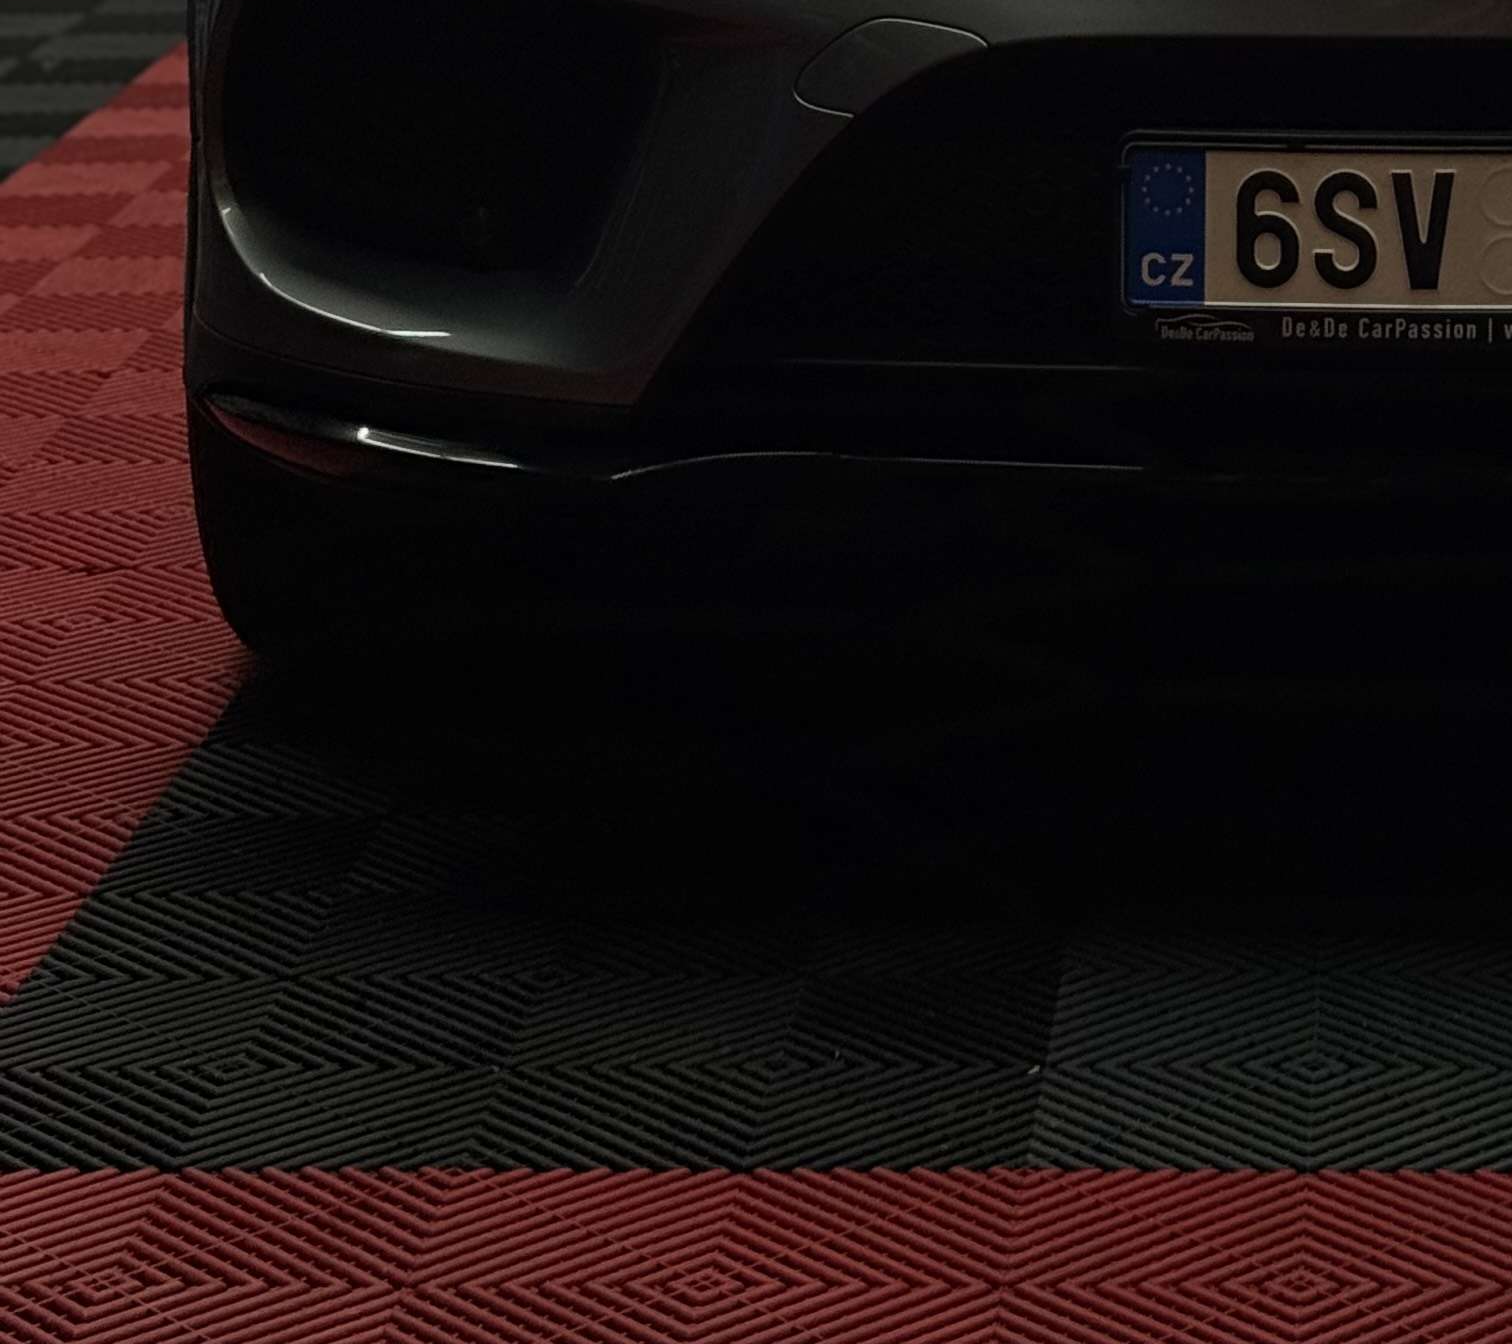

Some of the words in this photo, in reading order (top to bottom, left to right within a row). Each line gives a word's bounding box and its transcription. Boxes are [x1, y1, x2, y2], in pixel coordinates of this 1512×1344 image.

[1235, 169, 1455, 291] 6SV
[1140, 251, 1195, 287] CZ
[1281, 316, 1348, 339] De&De
[1358, 317, 1477, 340] CarPassion
